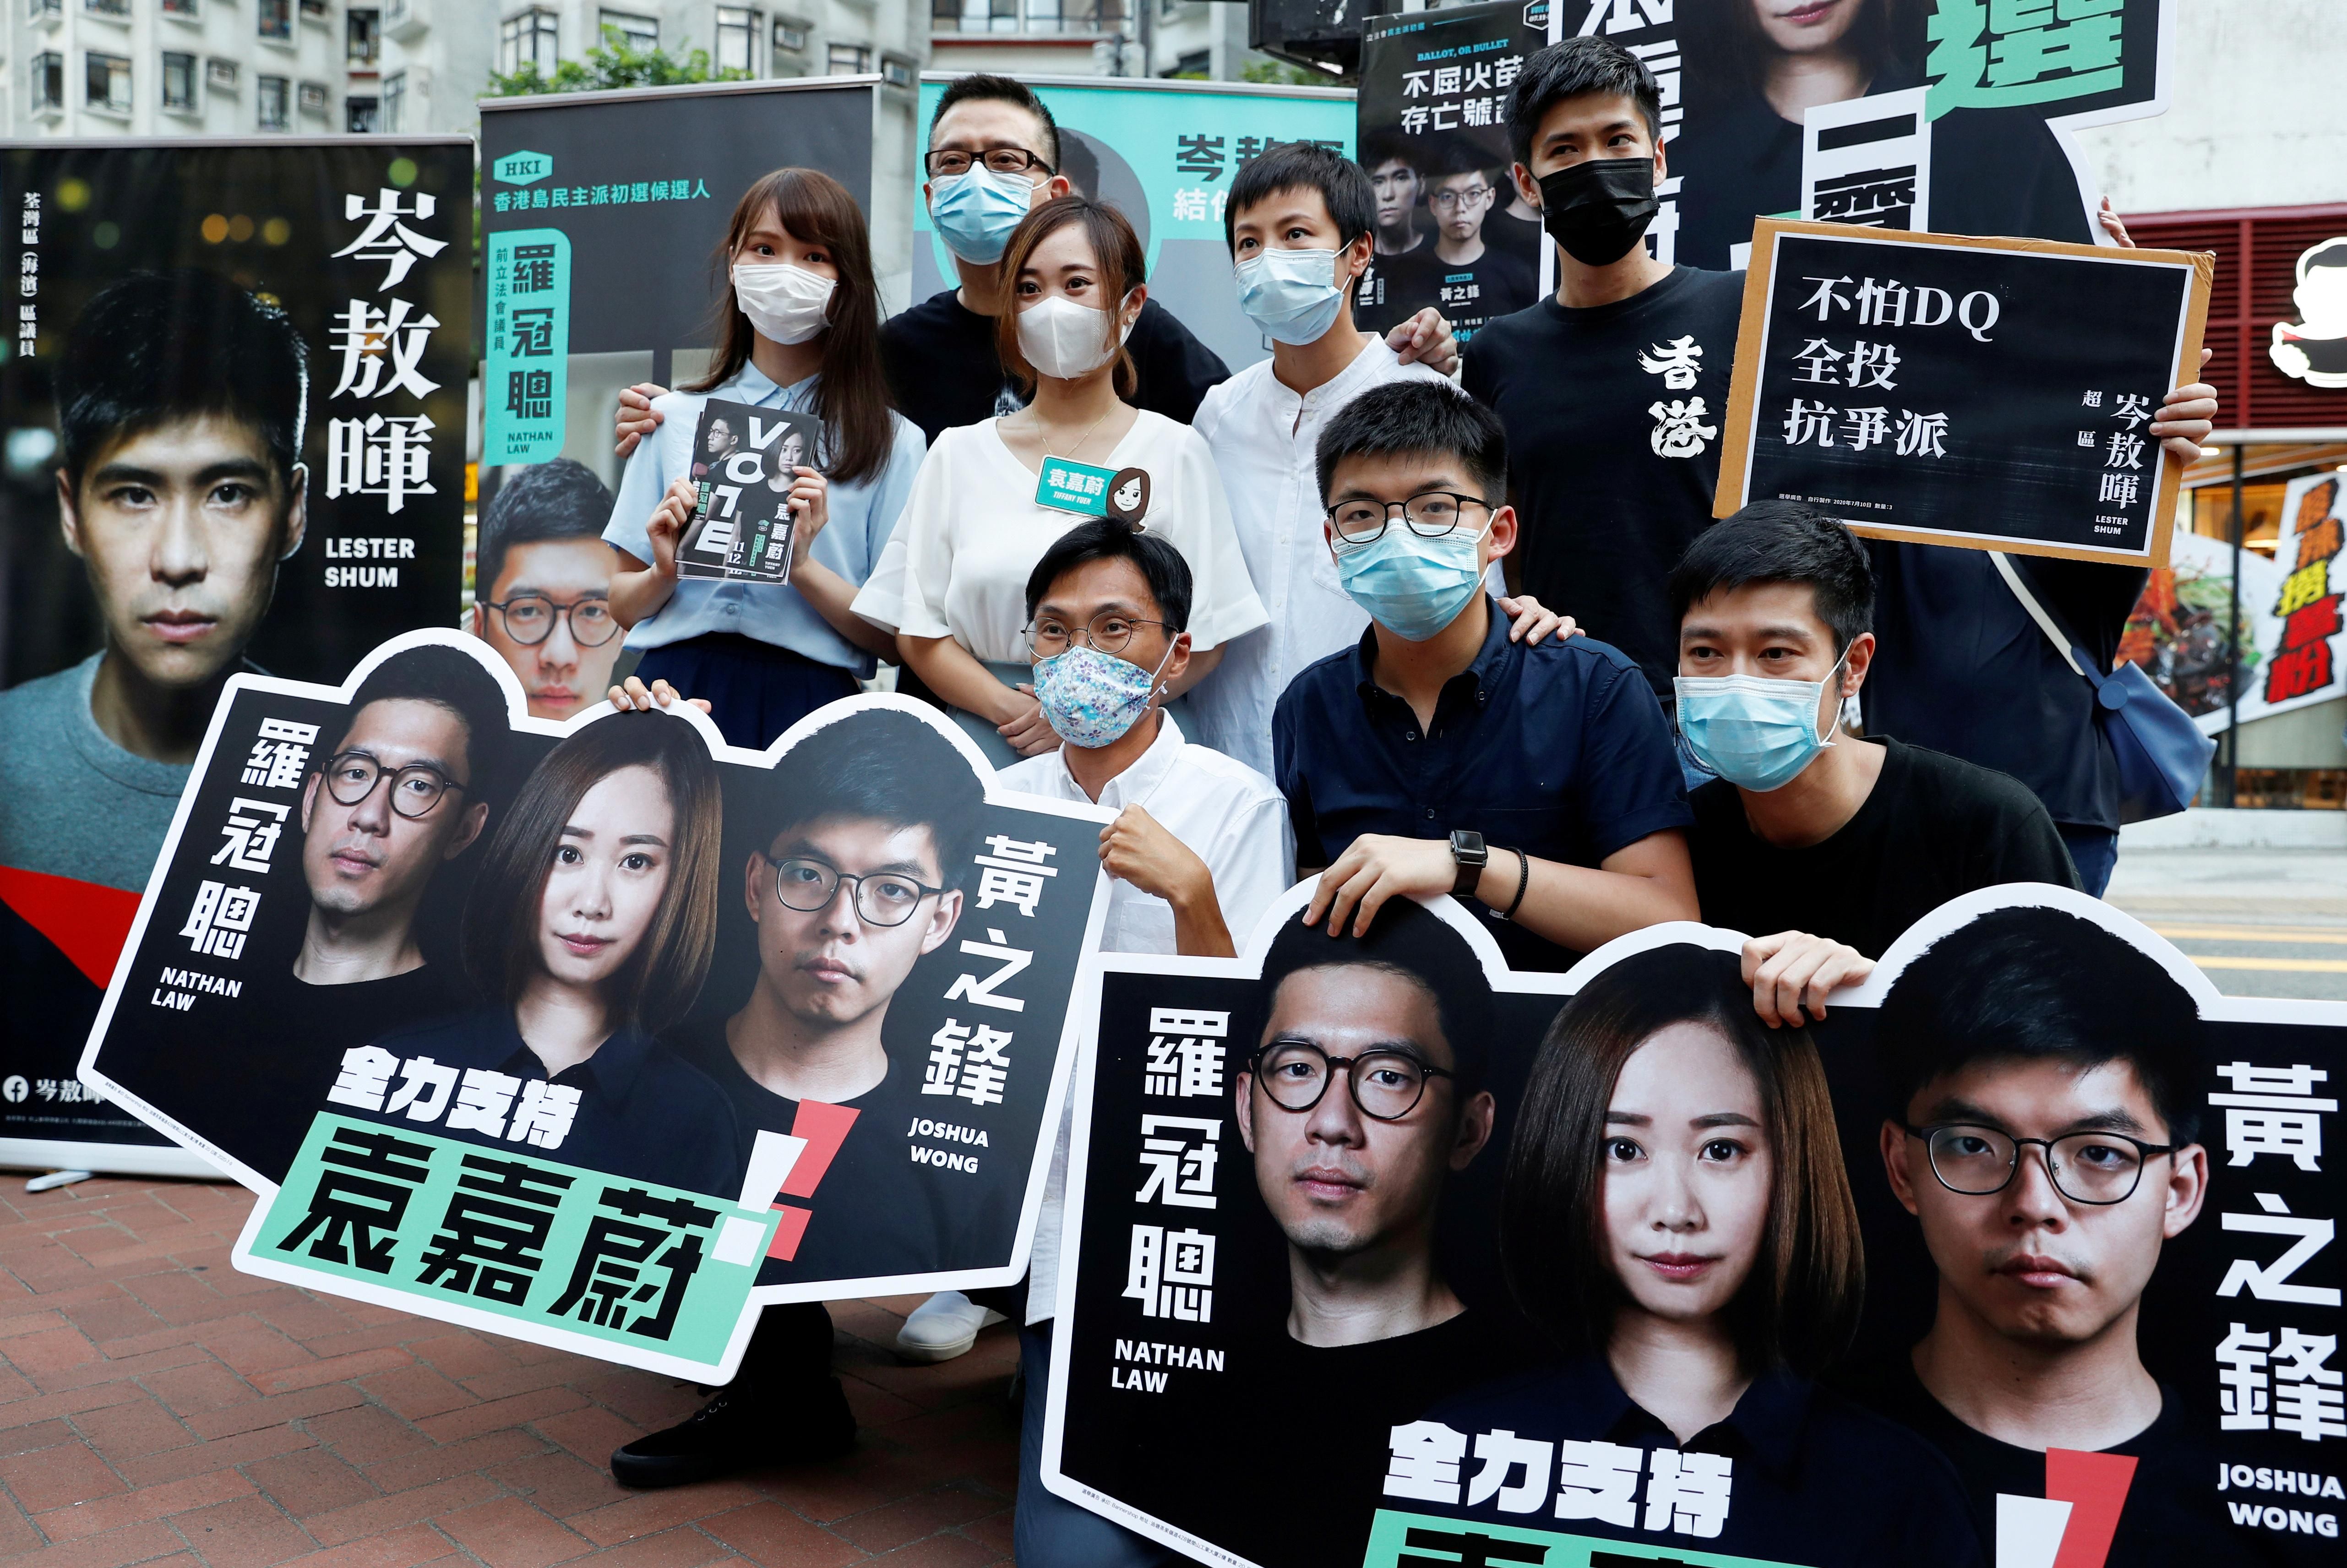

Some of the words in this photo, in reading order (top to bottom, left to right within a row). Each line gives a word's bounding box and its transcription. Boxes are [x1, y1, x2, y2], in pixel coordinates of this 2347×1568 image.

[1417, 48, 1457, 61] BALLOT,
[1458, 45, 1472, 55] OR
[1473, 38, 1509, 53] BULLET
[505, 160, 542, 177] HKI
[493, 178, 711, 213] 香港島民主派初選候選人
[493, 248, 508, 351] 前立法會議員
[1440, 284, 1480, 301] 黃之鋒
[1798, 275, 2000, 343] 不怕DQ
[506, 244, 557, 419] 羅冠聰
[326, 188, 449, 515] 岑敖暉
[1791, 338, 1901, 392] 全投
[1637, 334, 1717, 459] 香港
[507, 430, 553, 442] NATHAN
[1781, 397, 1949, 459] 抗爭派
[507, 443, 530, 455] LAW
[2098, 392, 2152, 511] 岑敖暉
[1048, 468, 1105, 496] 袁嘉蔚
[1053, 491, 1076, 502] TIFFANY
[1077, 496, 1092, 505] YUEN
[1833, 499, 1872, 508] 2020年7月10日
[2094, 525, 2122, 535] SHUM
[2095, 515, 2129, 526] LESTER
[326, 537, 415, 559] LESTER
[727, 553, 741, 565] 12
[733, 541, 745, 553] 11
[325, 566, 398, 588] SHUM
[179, 717, 321, 960] 羅冠聰
[160, 966, 243, 998] NATHAN
[920, 833, 1058, 1106] 黃之鋒
[151, 988, 196, 1011] LAW
[326, 1044, 583, 1150] 全力支持
[907, 1117, 989, 1149] JOSHUA
[910, 1145, 979, 1174] WONG
[1121, 1007, 1231, 1323] 羅冠聰
[2208, 1061, 2347, 1442] 黃之鋒
[1115, 1339, 1225, 1372] NATHAN
[1111, 1366, 1169, 1394] LAW
[1382, 1420, 1733, 1539] 全力支持
[2217, 1463, 2346, 1500] JOSHUA
[2227, 1502, 2338, 1538] WONG
